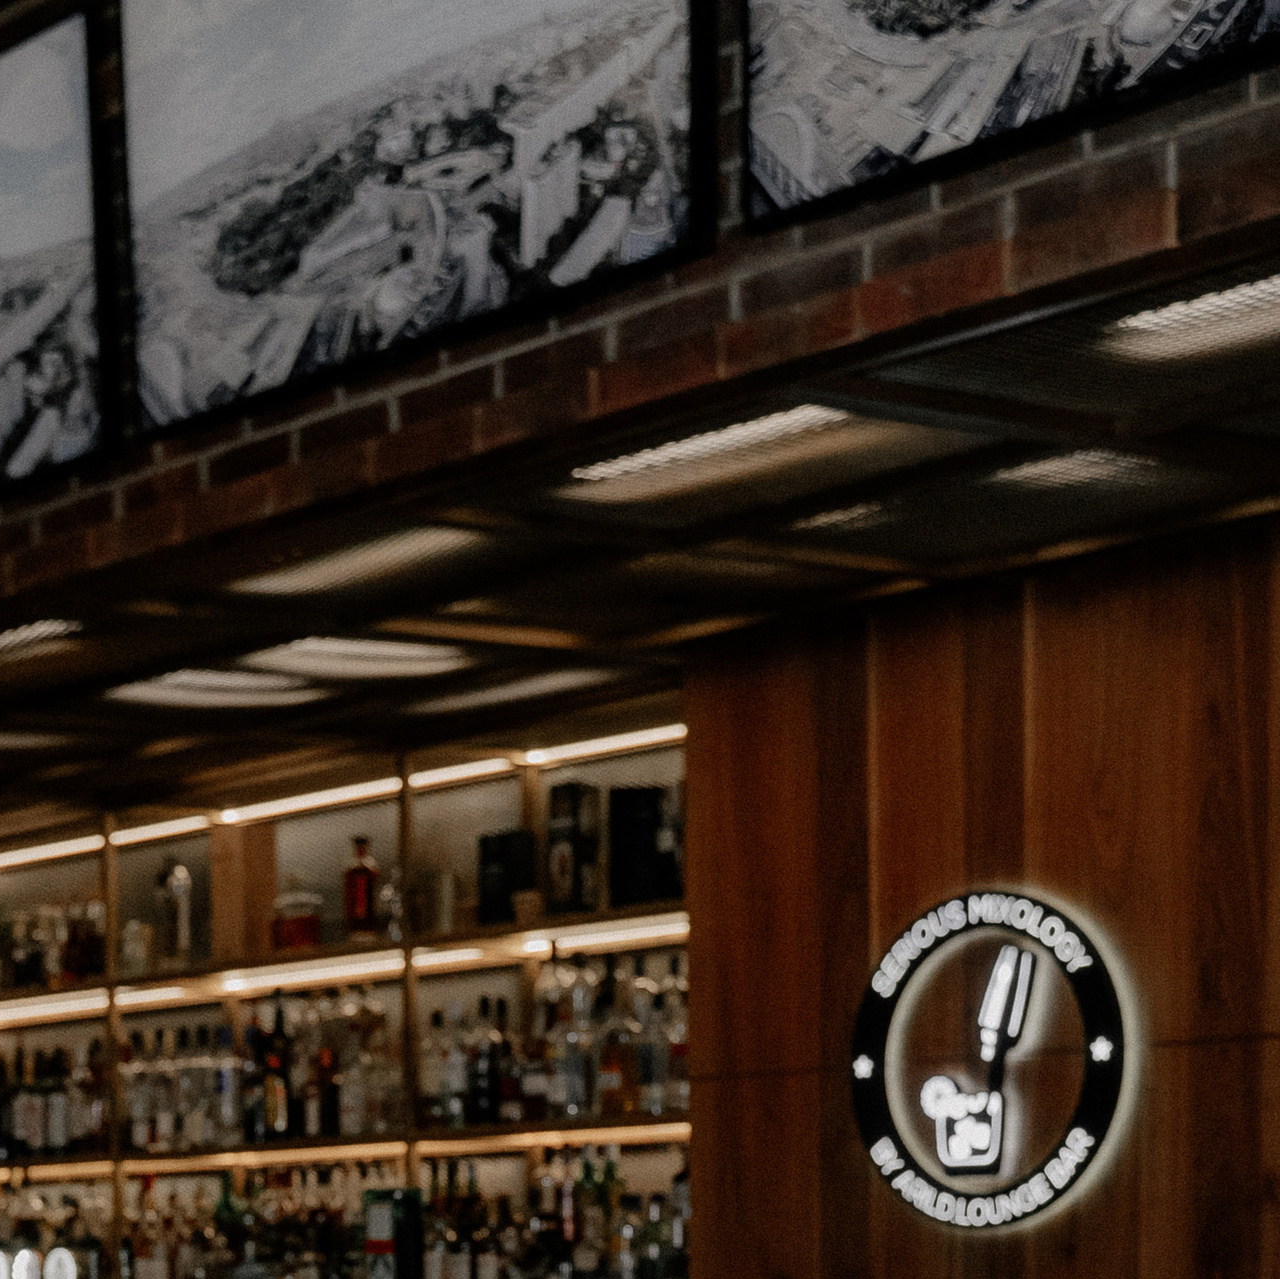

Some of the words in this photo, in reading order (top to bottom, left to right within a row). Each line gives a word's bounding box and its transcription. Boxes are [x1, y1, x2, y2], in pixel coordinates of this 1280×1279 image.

[968, 893, 1093, 973] MIXOLOGY
[870, 1136, 905, 1176] BY
[891, 1169, 956, 1222] ARILD
[951, 1173, 1055, 1227] LOUNGE
[1044, 1127, 1095, 1189] BAR
